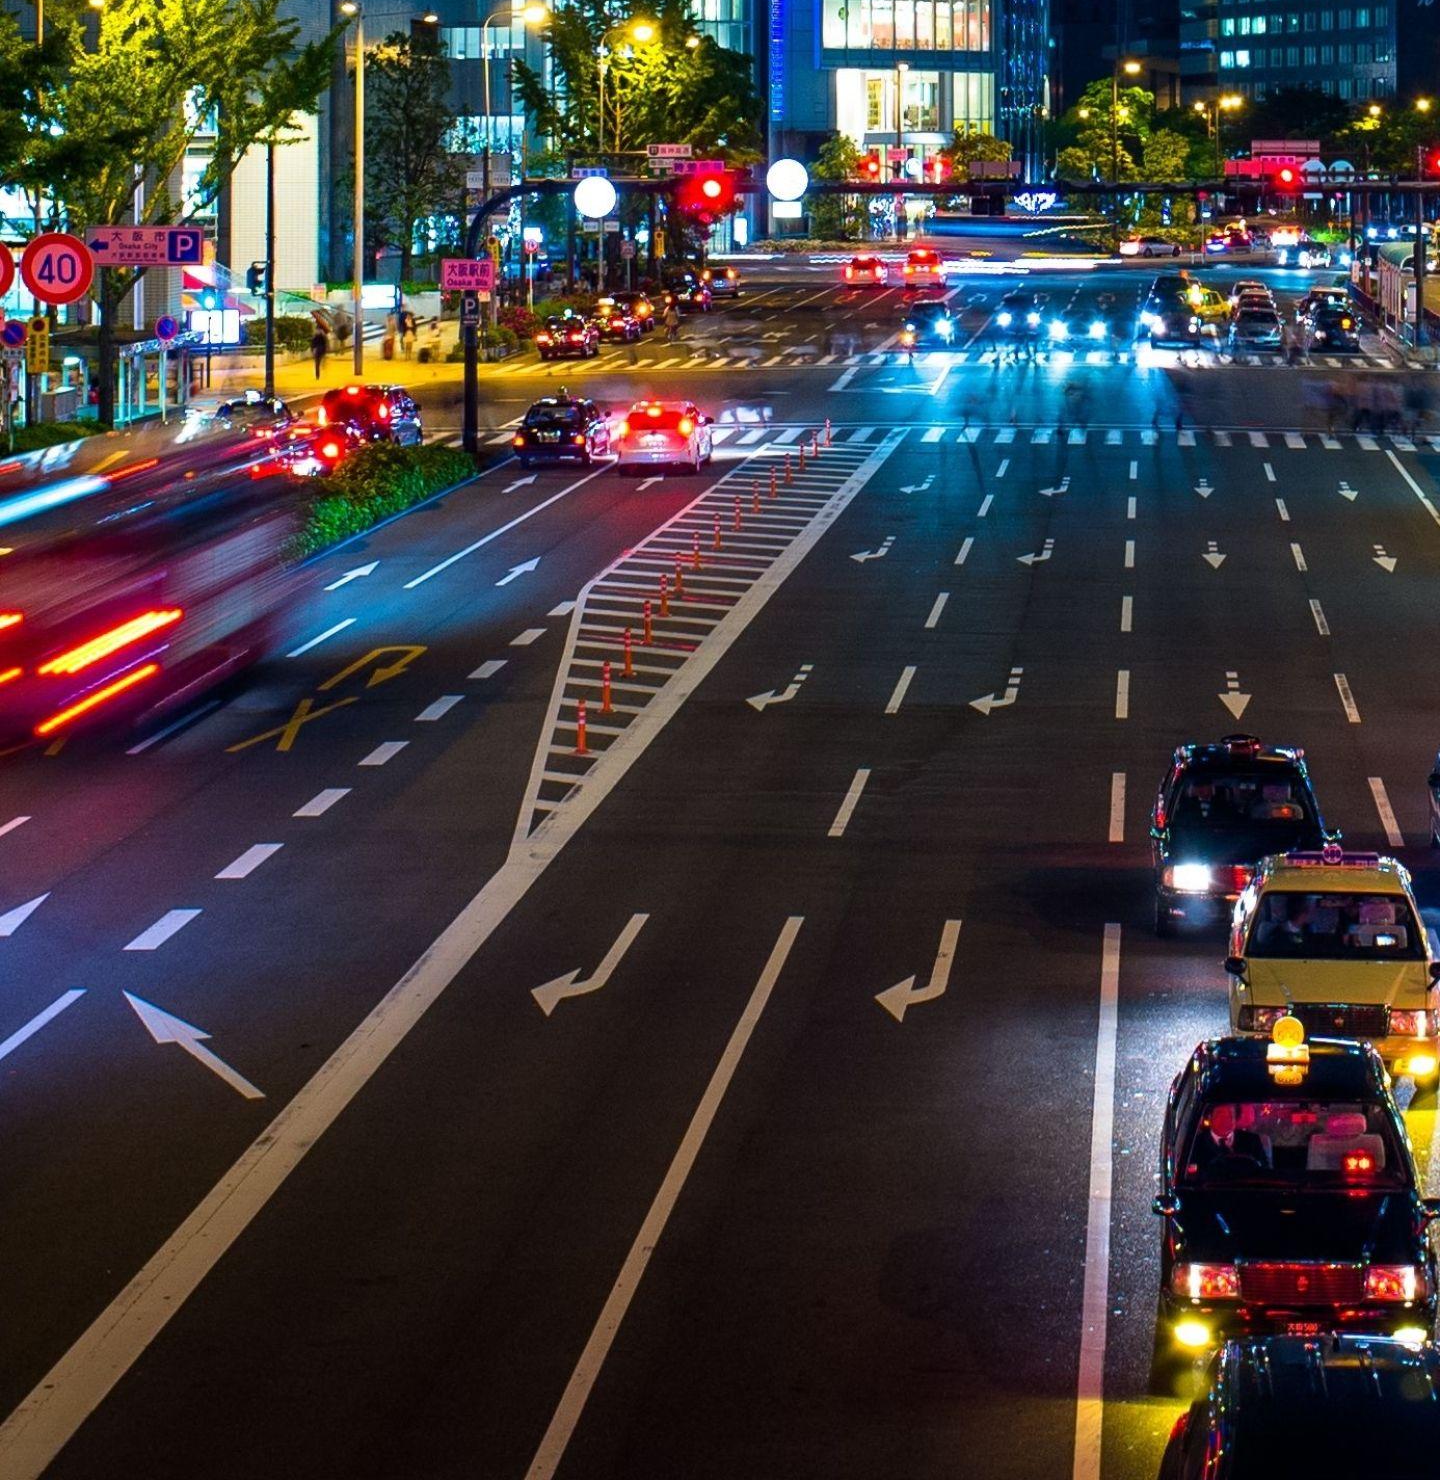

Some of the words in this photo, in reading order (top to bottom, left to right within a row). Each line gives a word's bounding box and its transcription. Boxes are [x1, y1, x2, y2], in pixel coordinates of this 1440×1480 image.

[111, 231, 165, 242] 大阪市
[177, 235, 193, 258] P
[38, 254, 76, 284] 40
[465, 299, 476, 314] P
